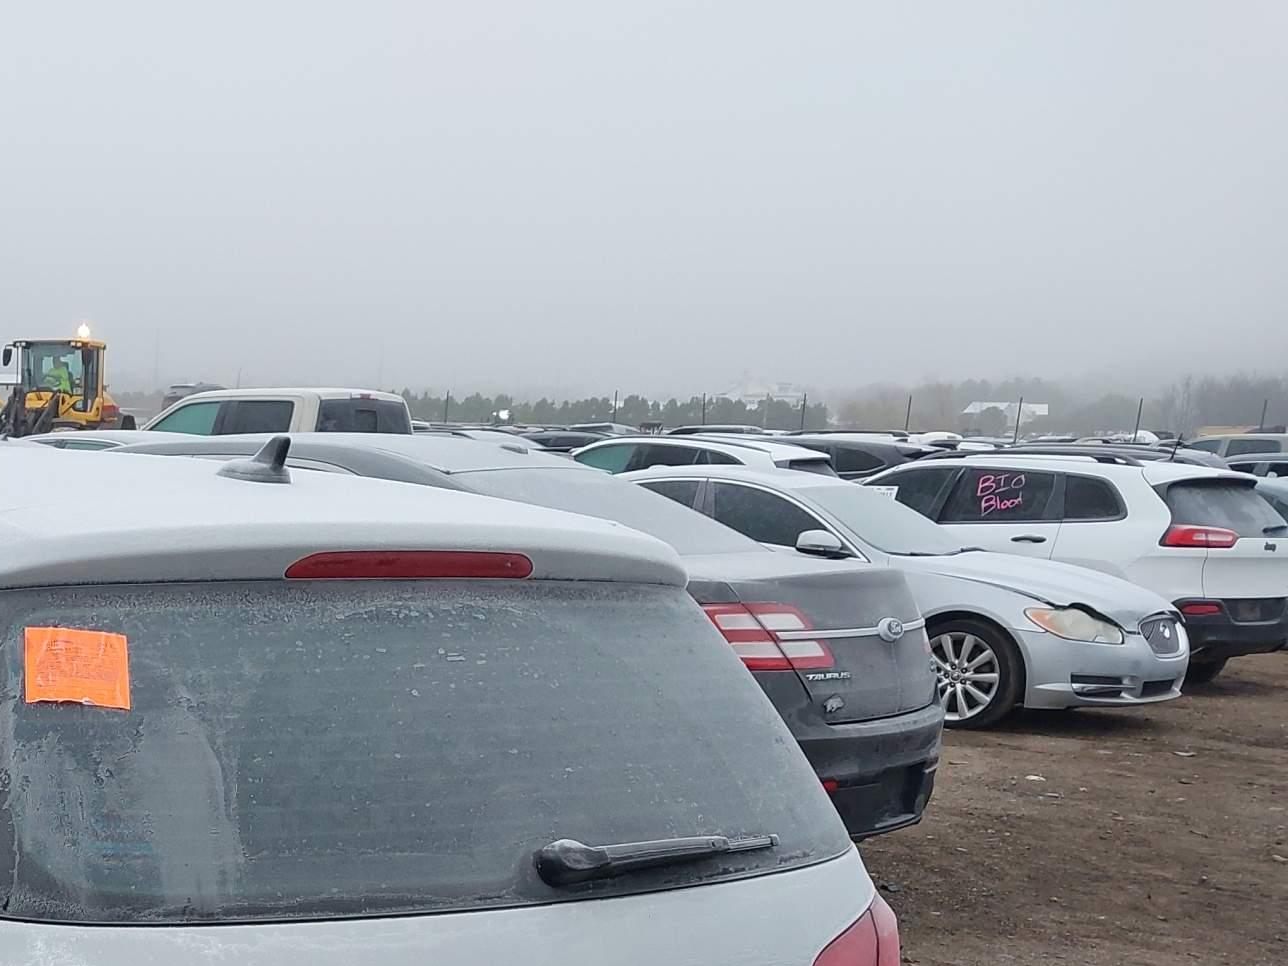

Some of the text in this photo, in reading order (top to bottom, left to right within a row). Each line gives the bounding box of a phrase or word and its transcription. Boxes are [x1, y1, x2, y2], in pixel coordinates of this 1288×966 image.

[977, 474, 1025, 496] BIO
[981, 491, 1022, 516] Blood
[806, 672, 850, 680] TAURUS
